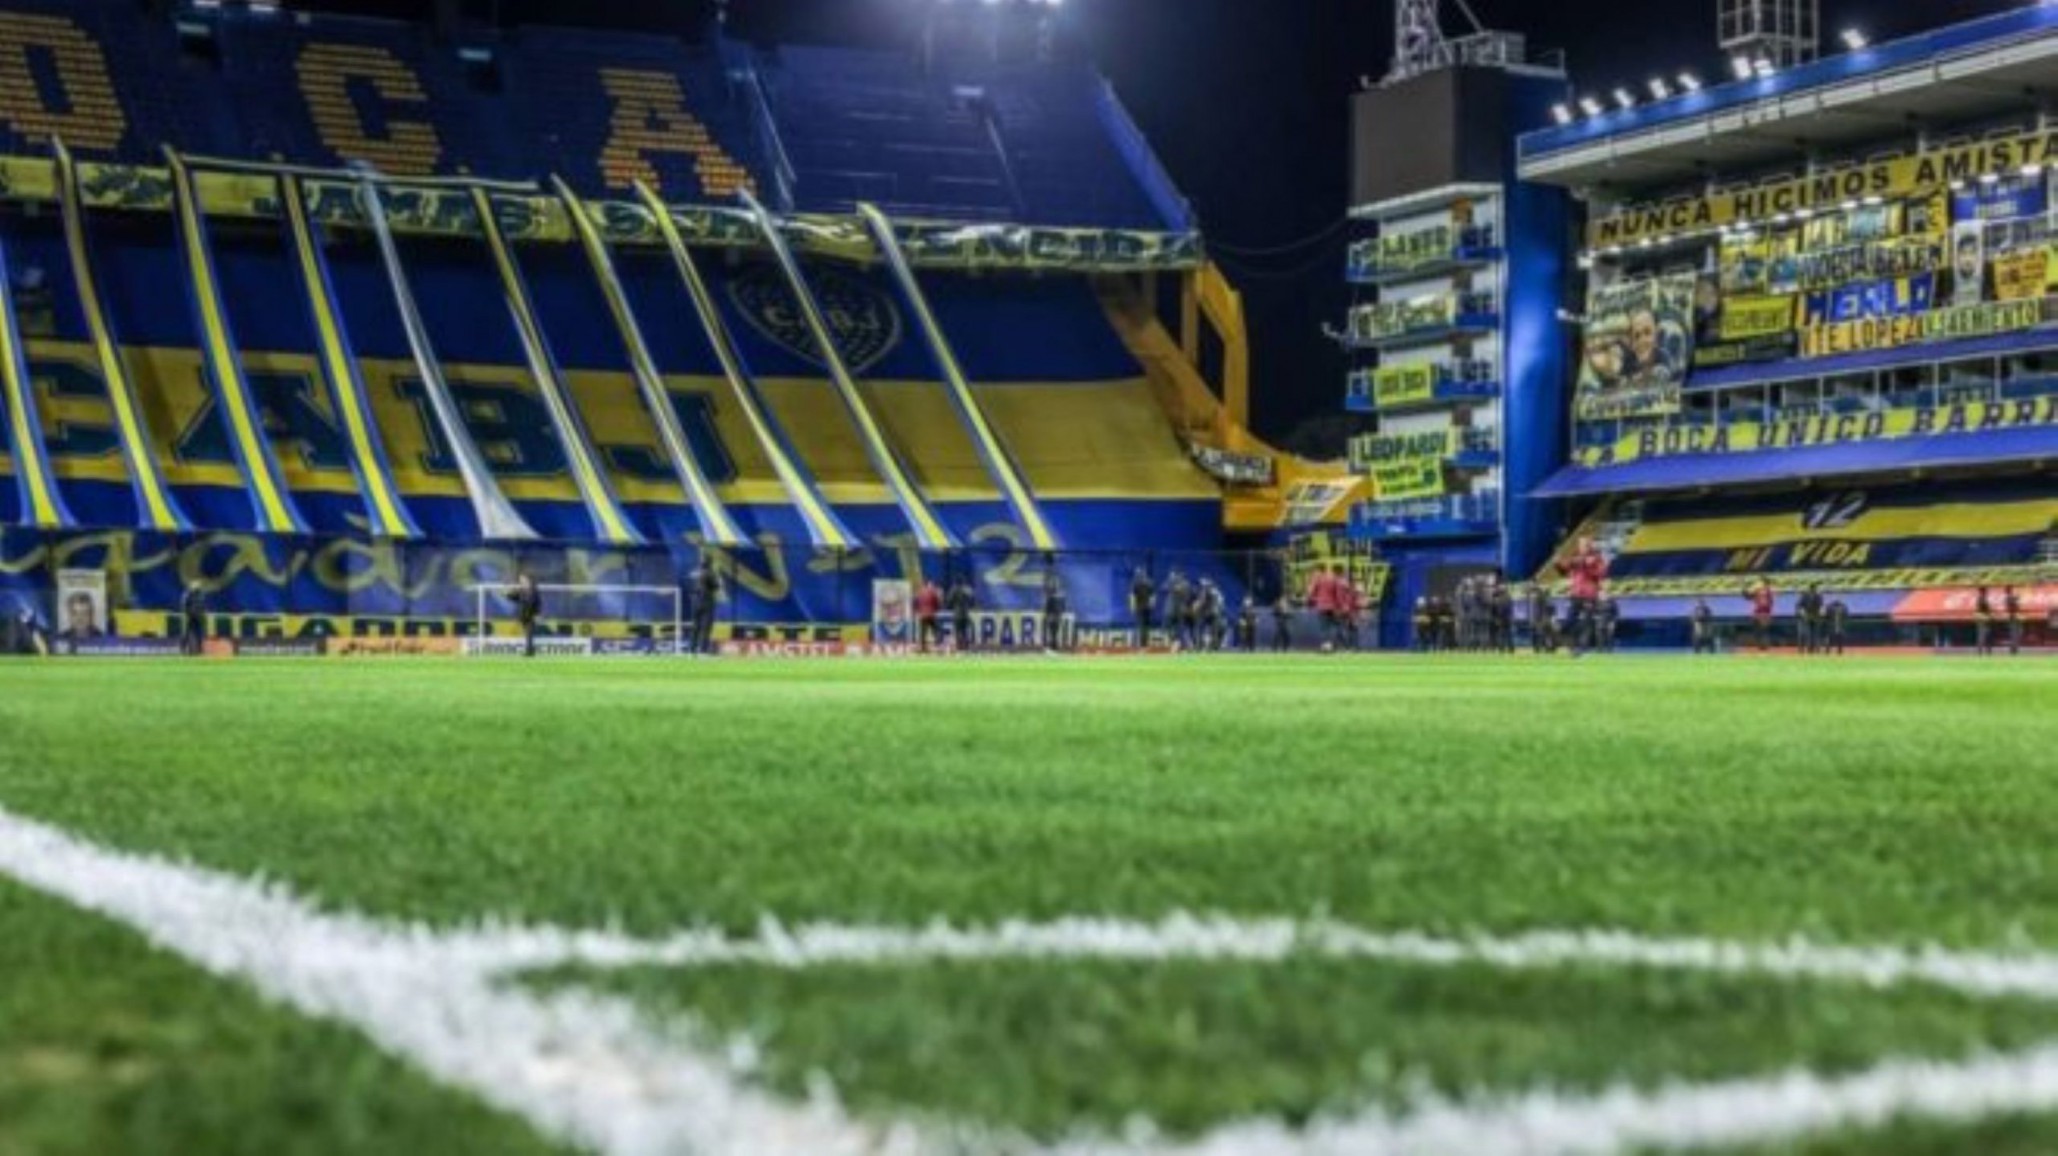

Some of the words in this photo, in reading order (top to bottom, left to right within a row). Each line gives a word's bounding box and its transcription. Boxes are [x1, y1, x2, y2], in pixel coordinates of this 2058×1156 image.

[1600, 202, 1711, 239] NUNCA
[1734, 165, 1890, 220] HICIMOS
[1640, 425, 1729, 455] BOCA
[1756, 411, 1885, 447] UNICO
[1807, 491, 1867, 528] 12
[1789, 541, 1871, 567] VIDA
